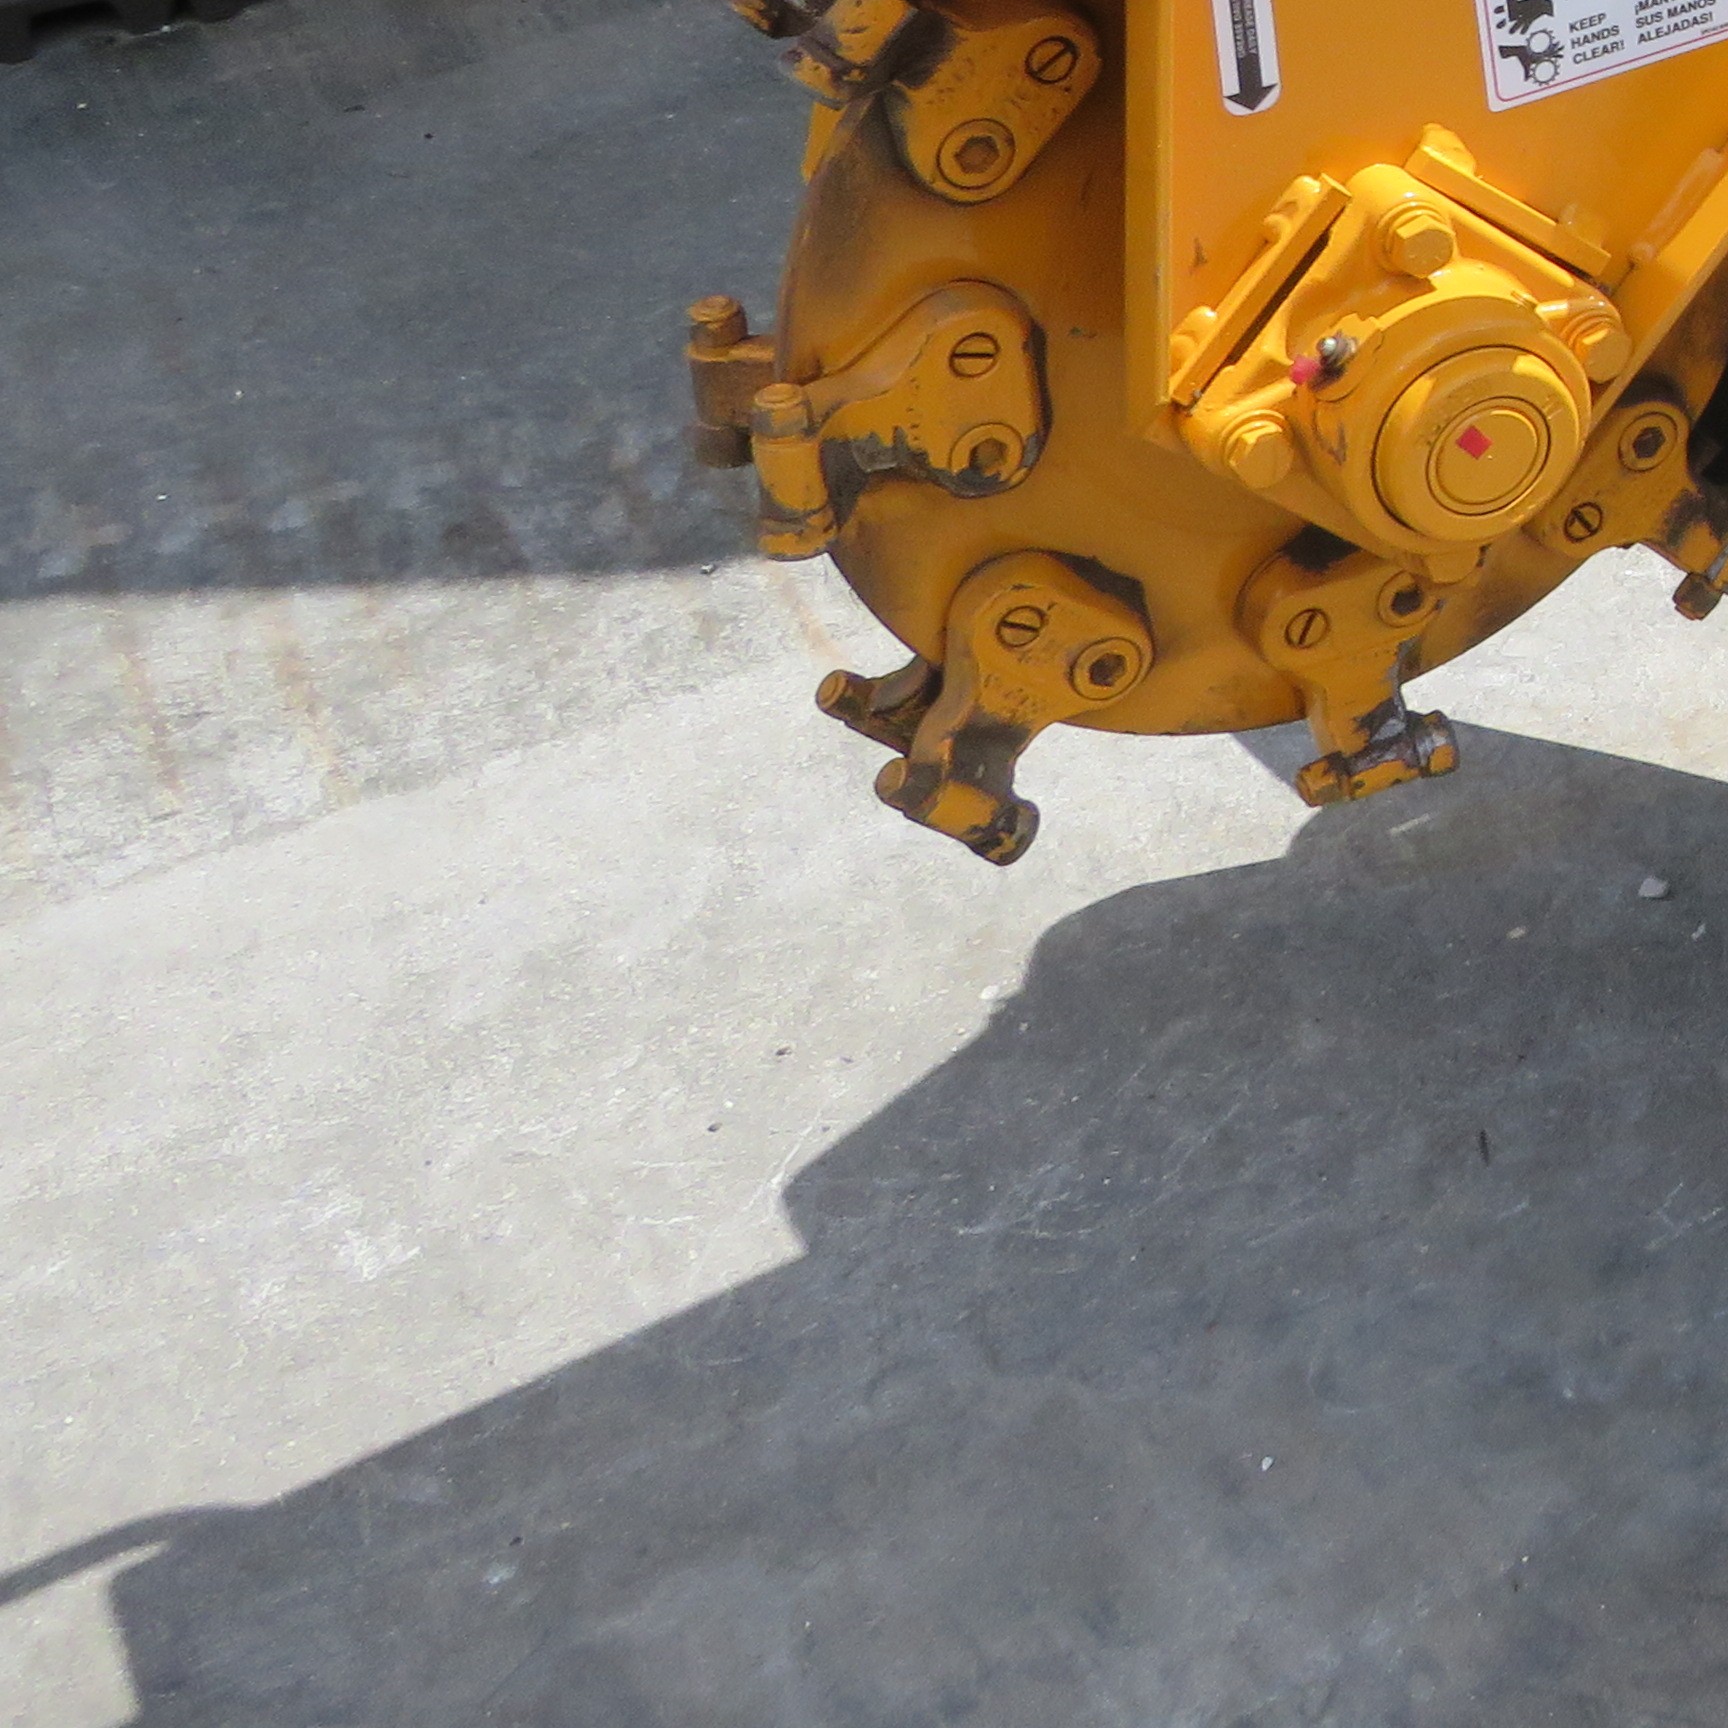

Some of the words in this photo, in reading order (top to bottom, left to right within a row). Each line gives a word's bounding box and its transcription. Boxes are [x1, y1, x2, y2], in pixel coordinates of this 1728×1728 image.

[1569, 12, 1607, 33] KEEP
[1636, 10, 1663, 28] SUS
[1637, 12, 1714, 45] ALEJADAS!
[1570, 25, 1620, 49] HANDS
[1573, 41, 1625, 66] CLEAR!
